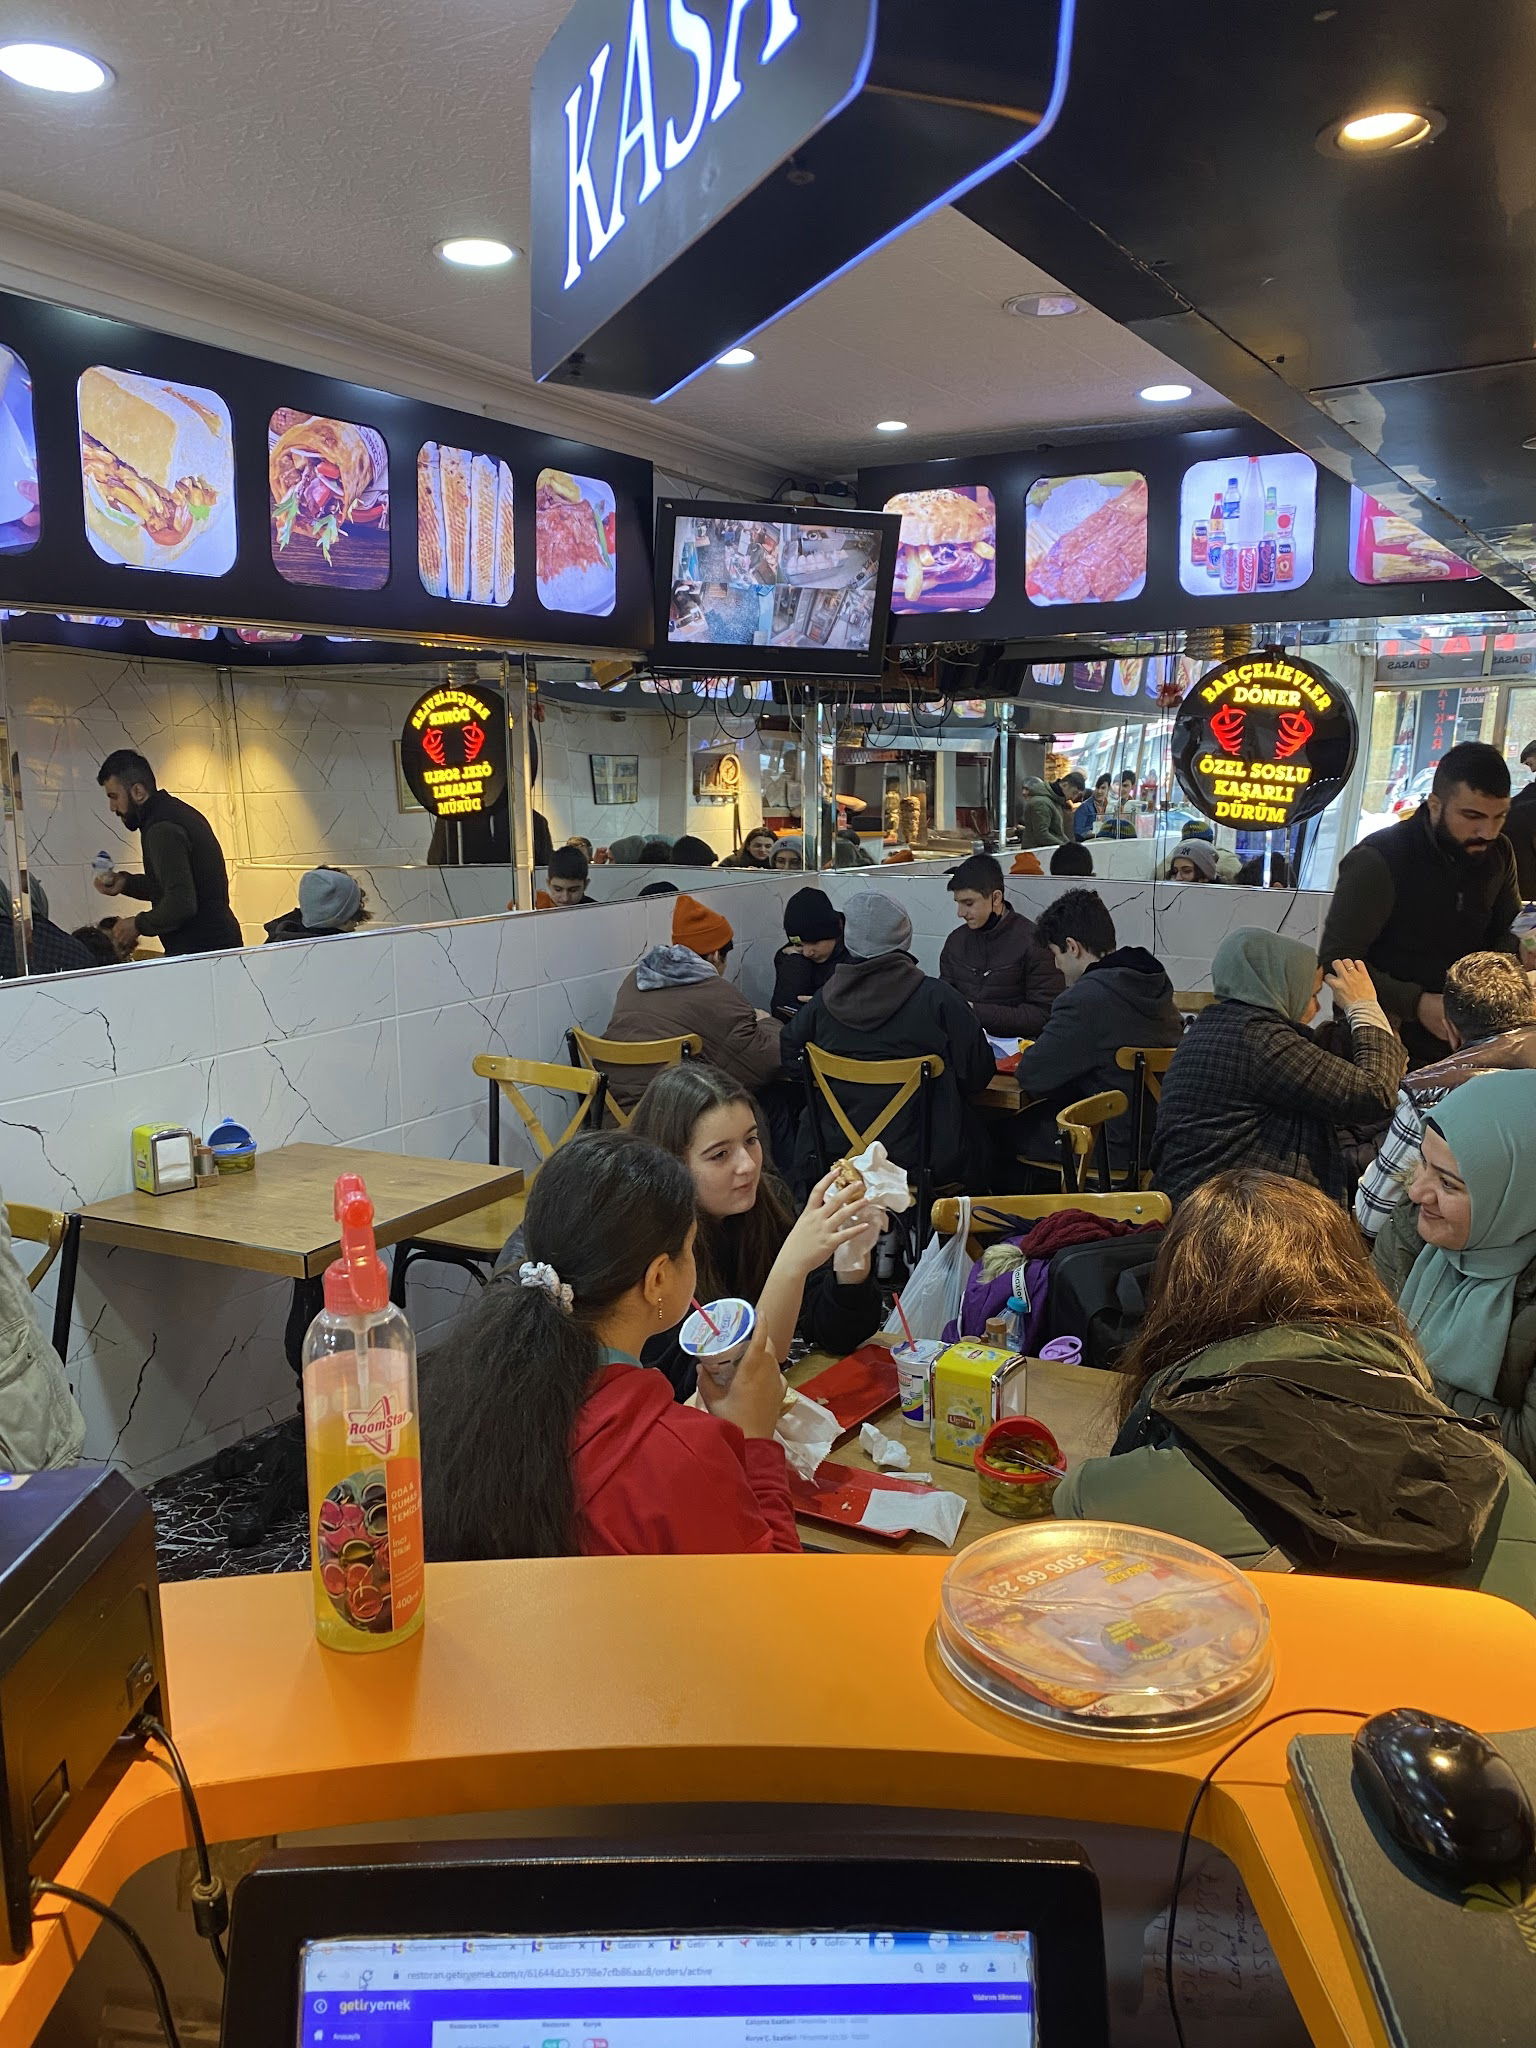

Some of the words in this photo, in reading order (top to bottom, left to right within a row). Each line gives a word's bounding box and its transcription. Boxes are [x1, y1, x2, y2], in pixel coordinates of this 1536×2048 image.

[1201, 661, 1332, 711] BAHÇELİEVLER
[1233, 684, 1302, 707] DÖNER
[1199, 755, 1246, 777] ÖZEL
[1250, 763, 1312, 783] SOSLU
[1214, 780, 1295, 802] KAŞARLI
[1215, 801, 1287, 823] DÜRÜM
[350, 1411, 407, 1435] RoomStar
[1016, 1570, 1048, 1585] 66
[339, 1998, 411, 2015] getiryemek
